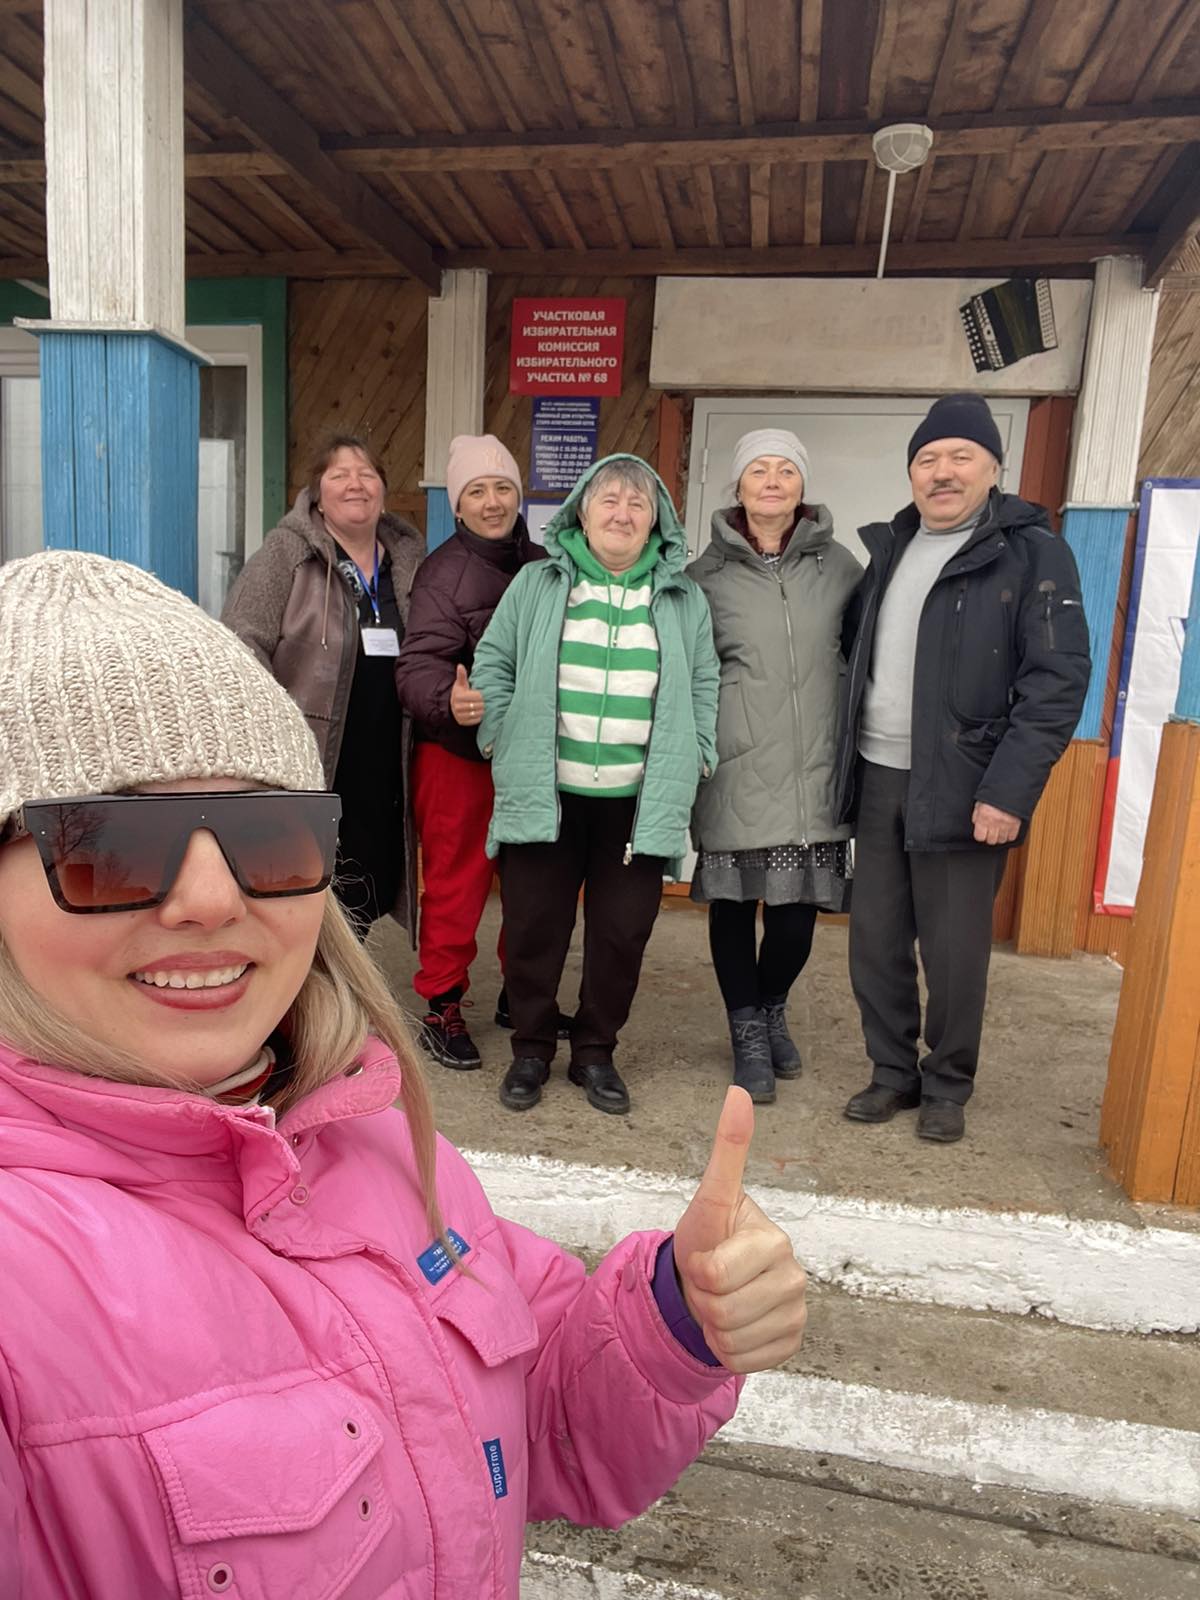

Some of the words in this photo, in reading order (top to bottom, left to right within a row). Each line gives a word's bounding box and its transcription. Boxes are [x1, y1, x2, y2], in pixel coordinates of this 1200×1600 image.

[533, 311, 605, 321] УЧАСТКОВАЯ
[523, 326, 617, 337] ИЗБИРАТЕЛЬНАЯ
[538, 342, 600, 352] КОМИССИЯ
[516, 357, 617, 368] ИЗБИРАТЕЛЬНОГО
[527, 372, 576, 383] УЧАСТКА
[578, 372, 591, 383] №
[594, 373, 608, 383] 68
[541, 434, 562, 442] РЕЖИМ
